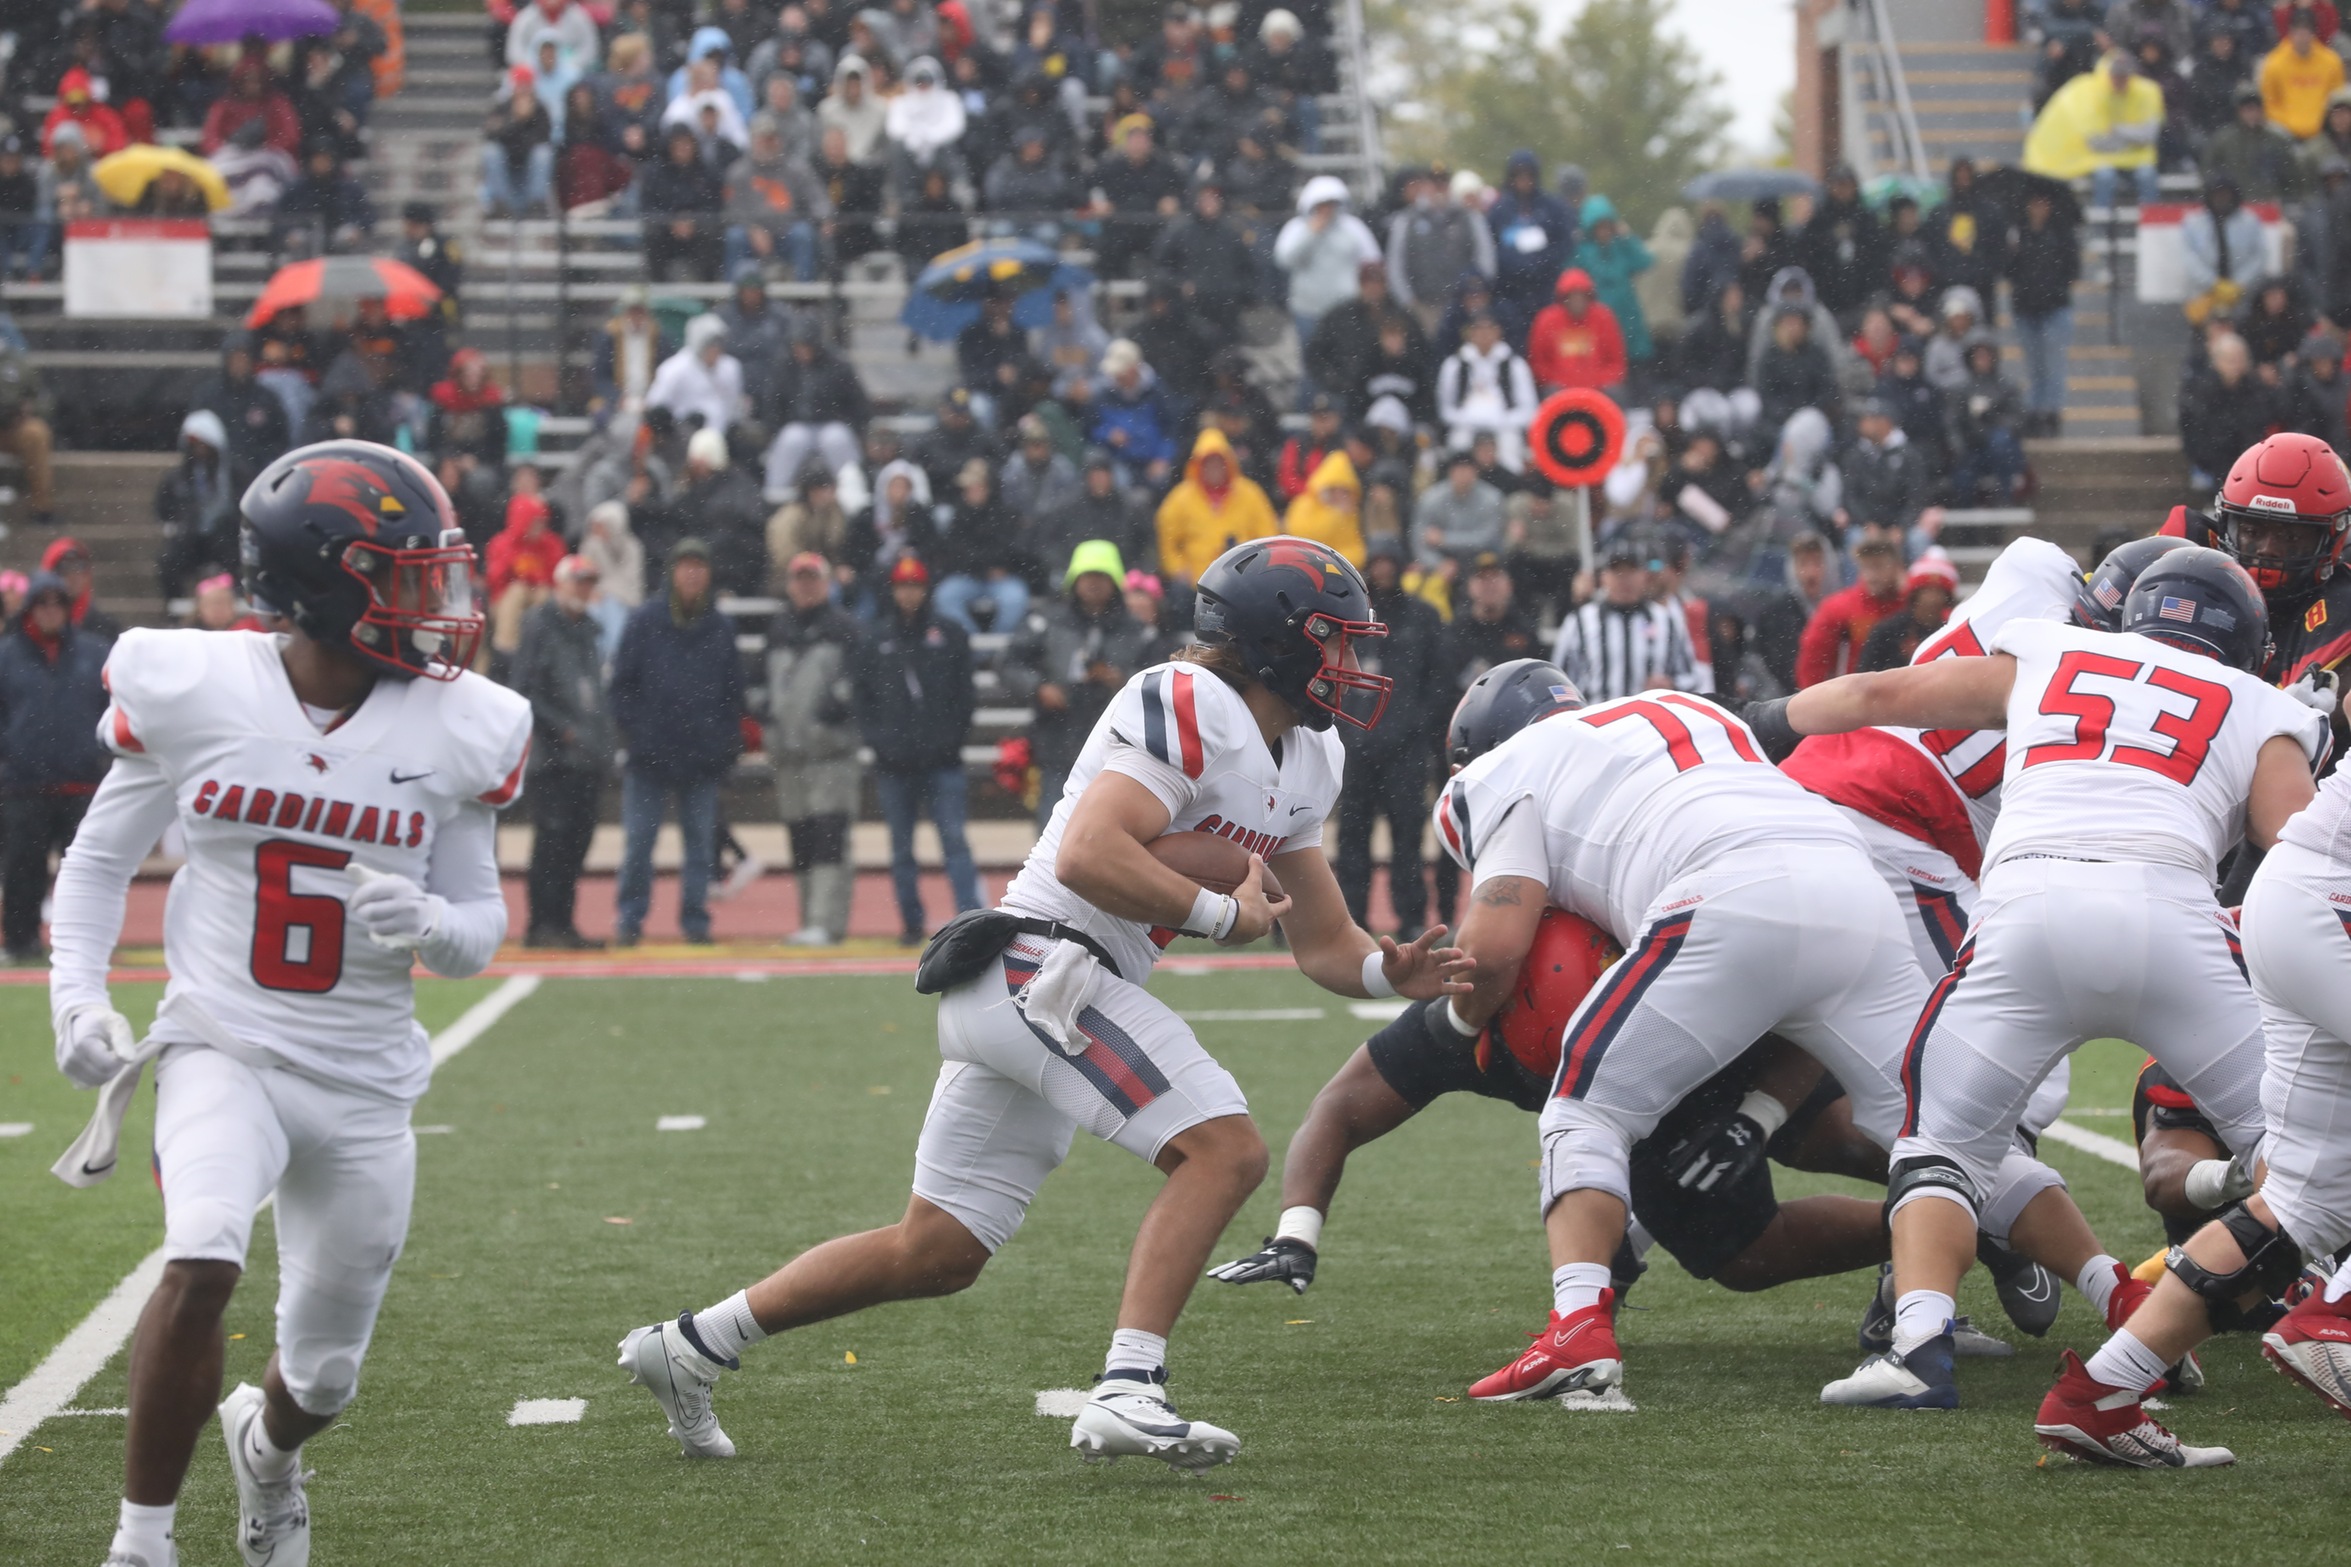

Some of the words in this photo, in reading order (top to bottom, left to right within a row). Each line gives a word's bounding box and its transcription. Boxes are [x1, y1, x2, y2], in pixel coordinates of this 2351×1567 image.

[2255, 497, 2290, 510] Riddell
[2022, 650, 2232, 787] 53
[193, 780, 426, 847] CARDINALS
[251, 838, 353, 993] 6
